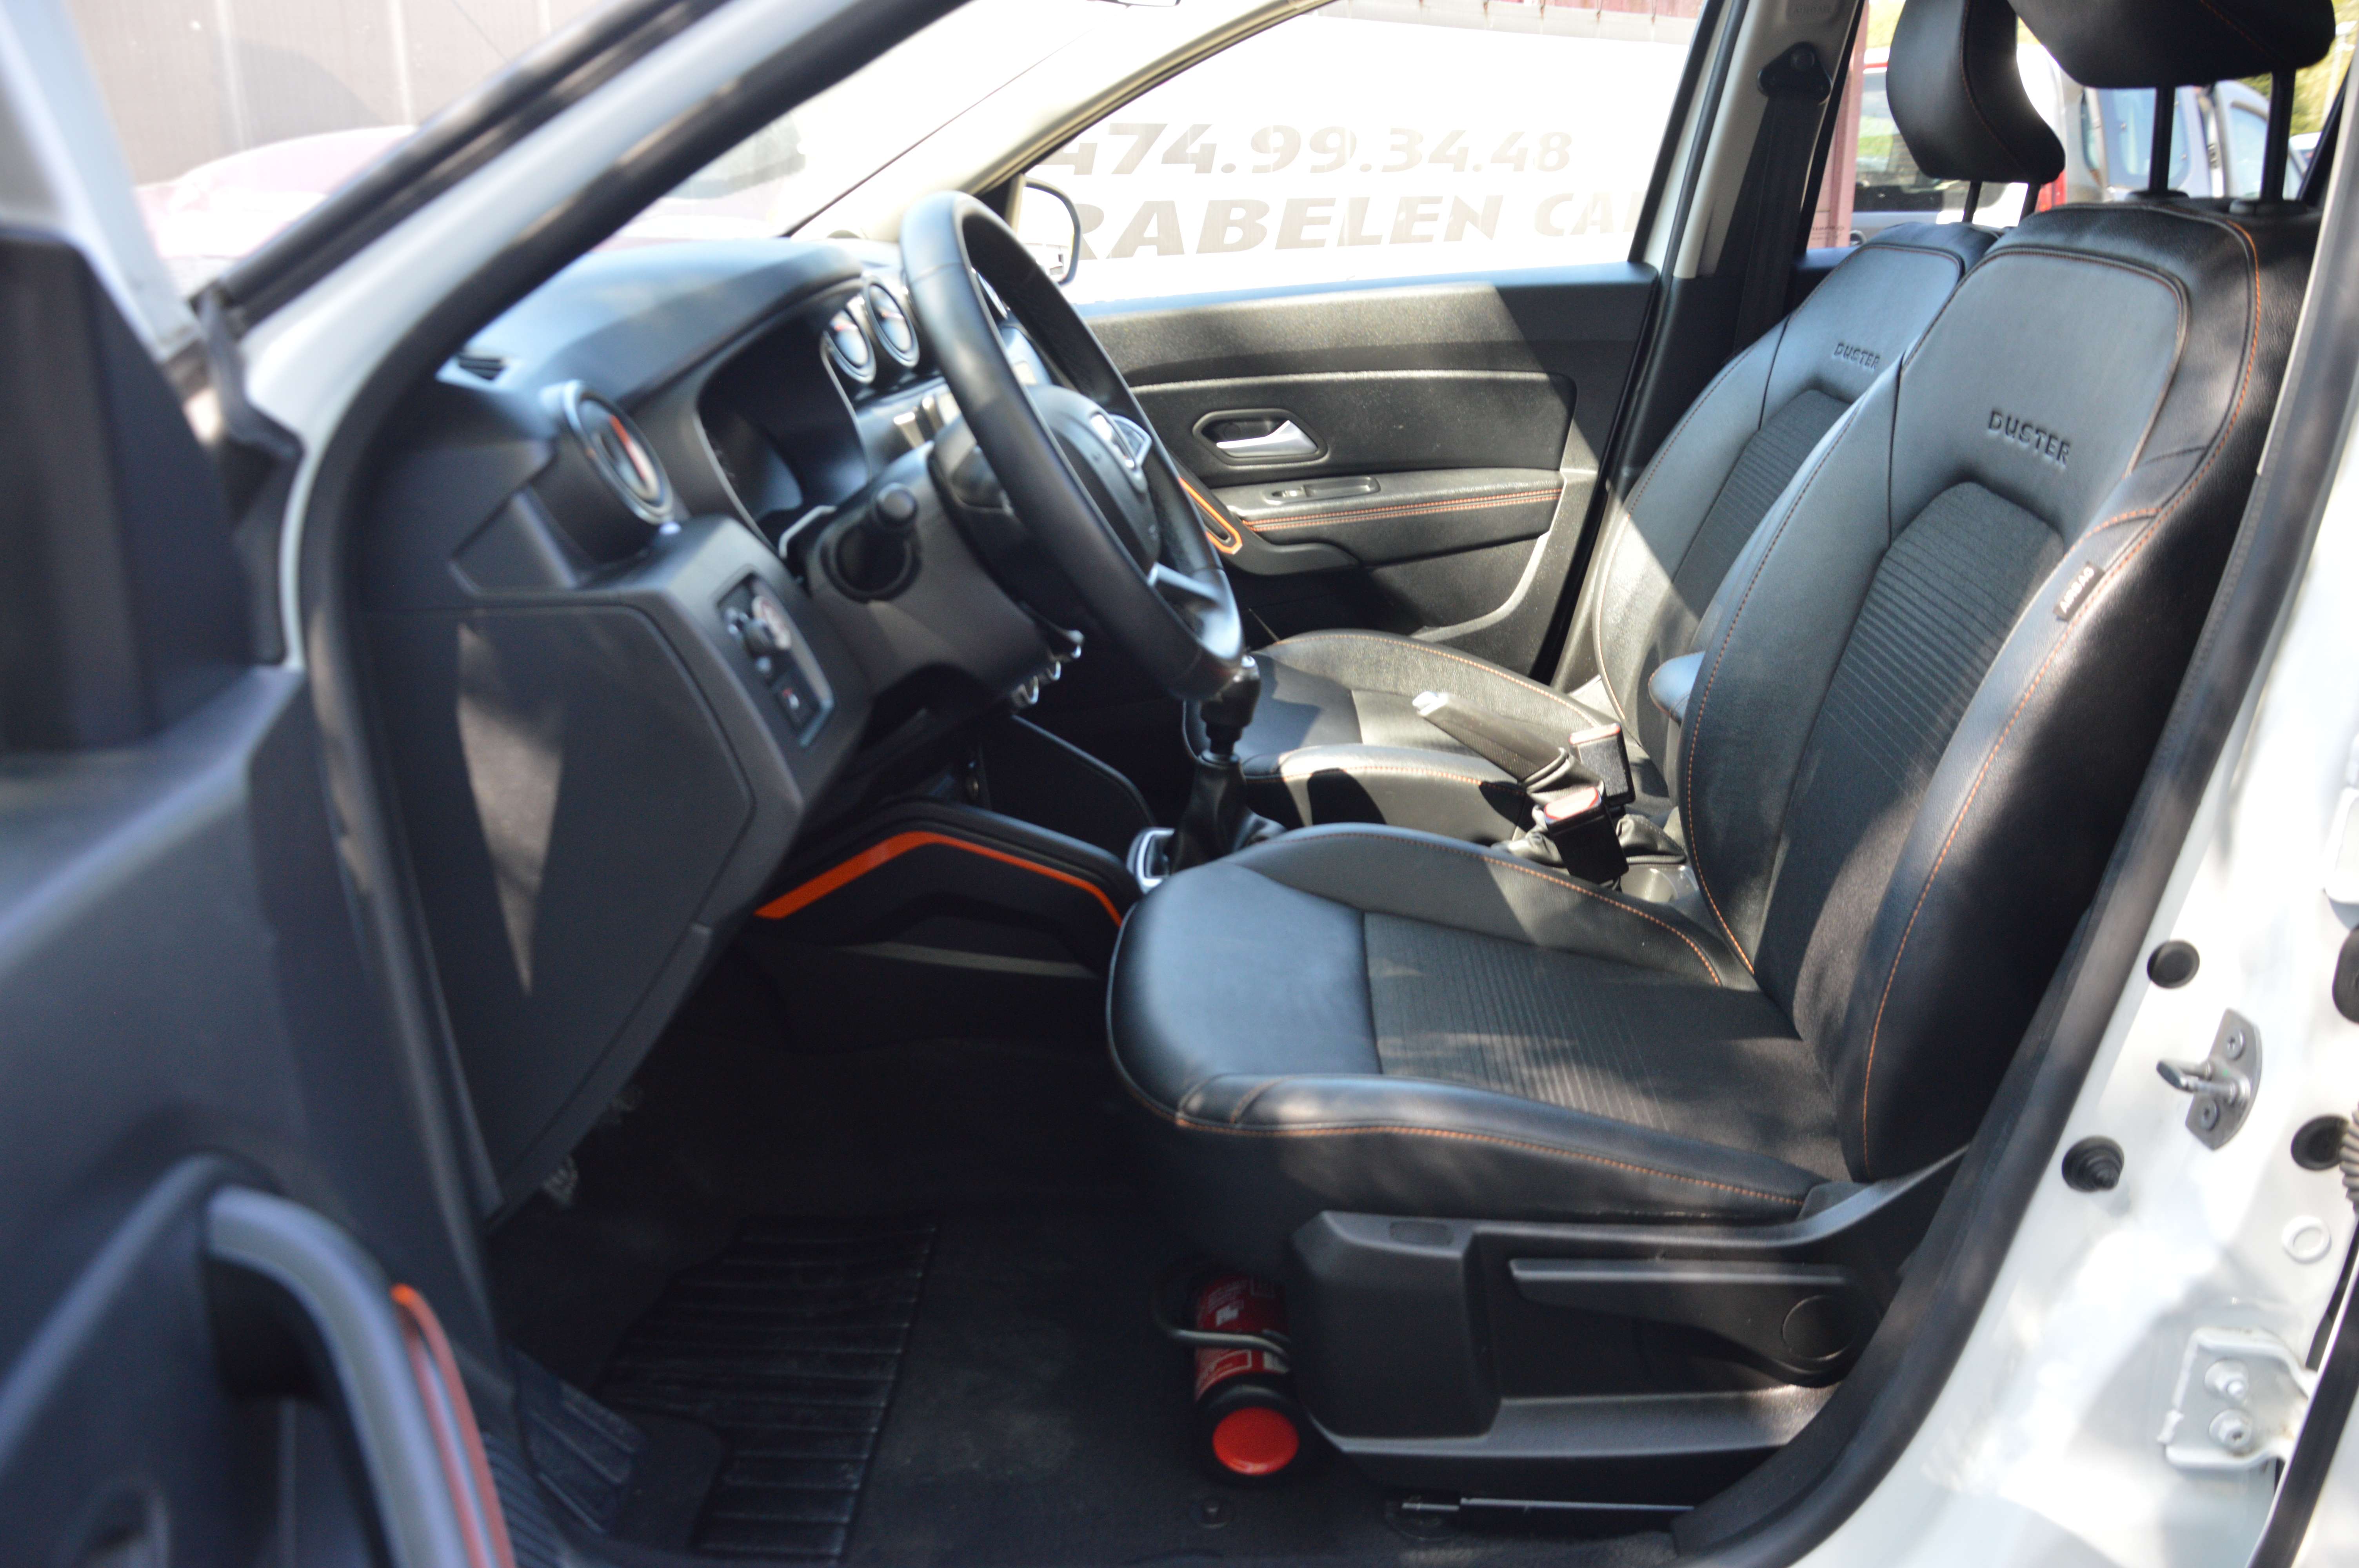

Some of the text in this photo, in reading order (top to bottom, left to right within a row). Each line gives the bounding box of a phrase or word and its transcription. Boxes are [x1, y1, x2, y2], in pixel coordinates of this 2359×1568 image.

[1834, 342, 1880, 369] DUSTER
[1988, 410, 2071, 464] DUSTER
[2060, 567, 2095, 613] AIRBAG
